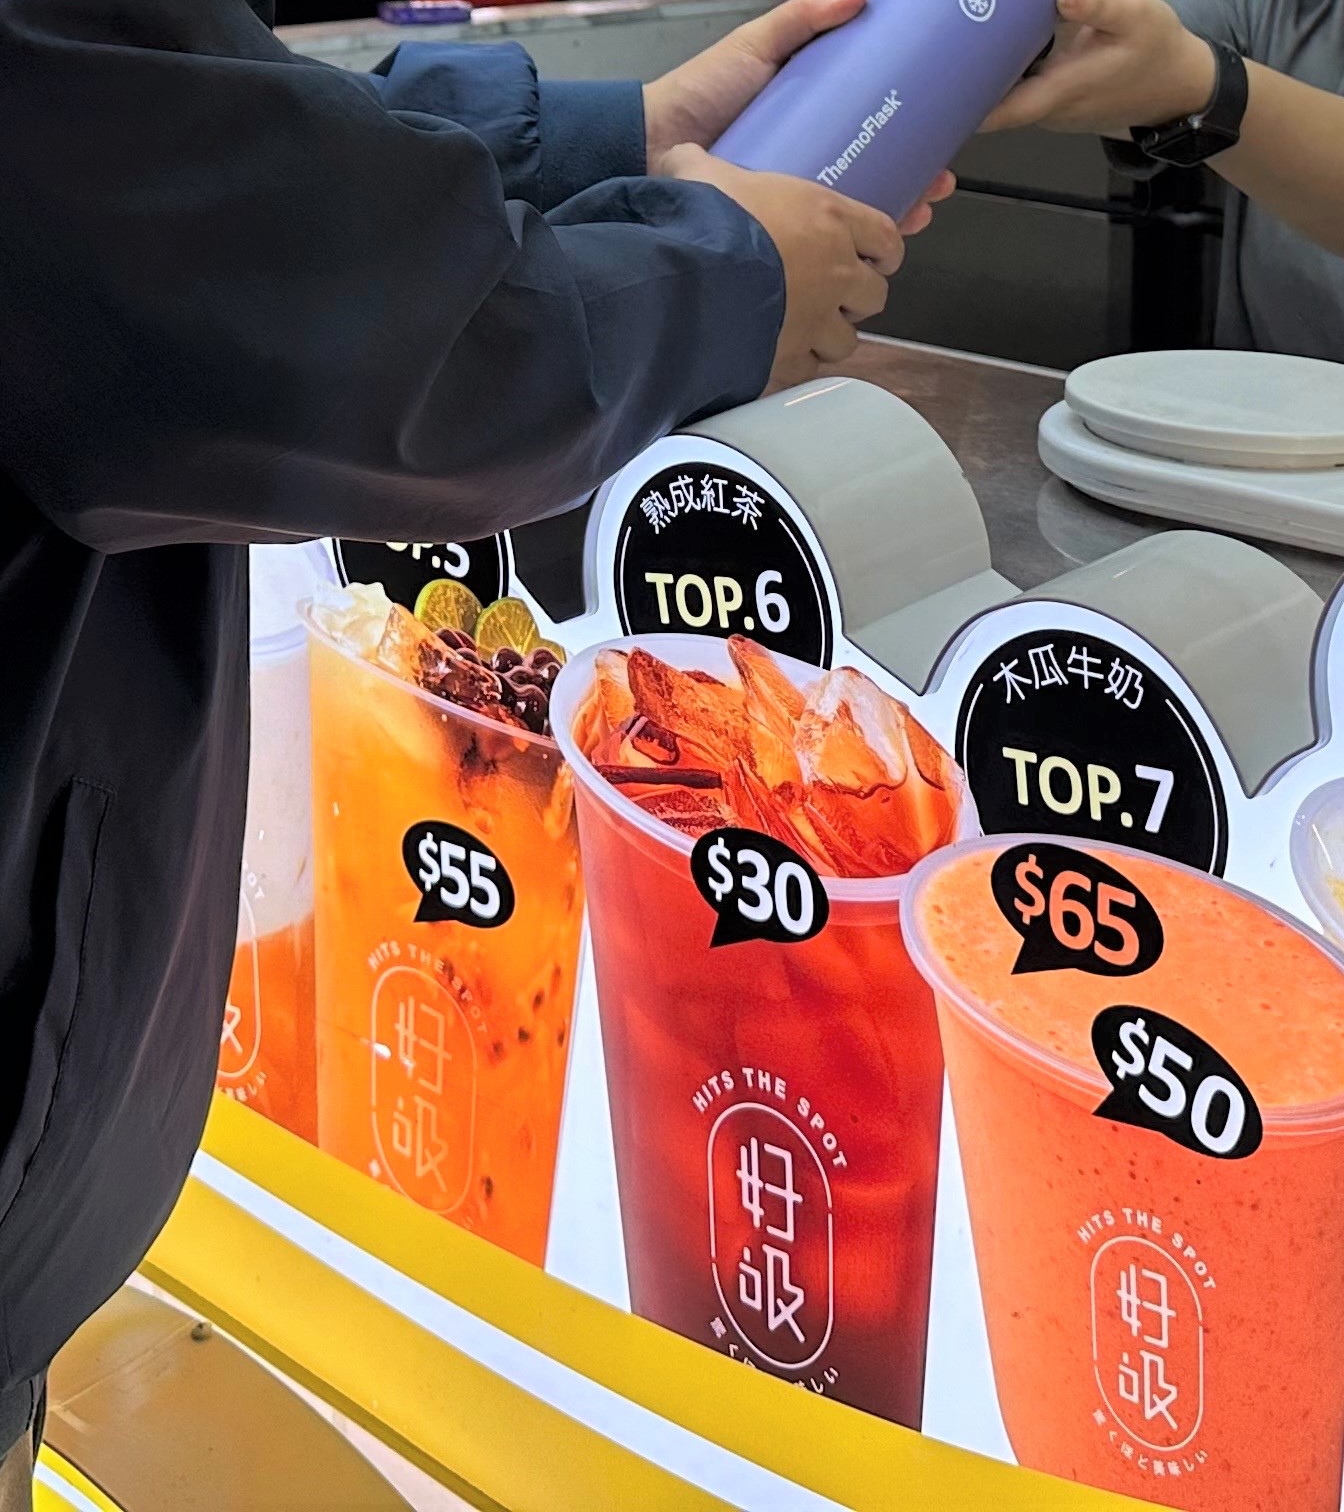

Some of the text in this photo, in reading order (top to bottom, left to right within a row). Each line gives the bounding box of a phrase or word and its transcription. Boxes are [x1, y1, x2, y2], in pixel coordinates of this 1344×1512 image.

[640, 473, 765, 534] 熟成紅茶
[645, 568, 791, 633] TOP.6
[992, 643, 1144, 710] 木瓜牛奶
[1002, 747, 1175, 833] TOP.7
[418, 832, 501, 919] $55
[708, 837, 815, 936] $30
[1014, 853, 1140, 967] $65
[367, 940, 401, 971] HITS
[408, 943, 445, 973] THE
[691, 1067, 848, 1168] HITS THE SPOT
[1111, 1018, 1246, 1155] $50
[1076, 1207, 1216, 1290] HITS THE SPOT
